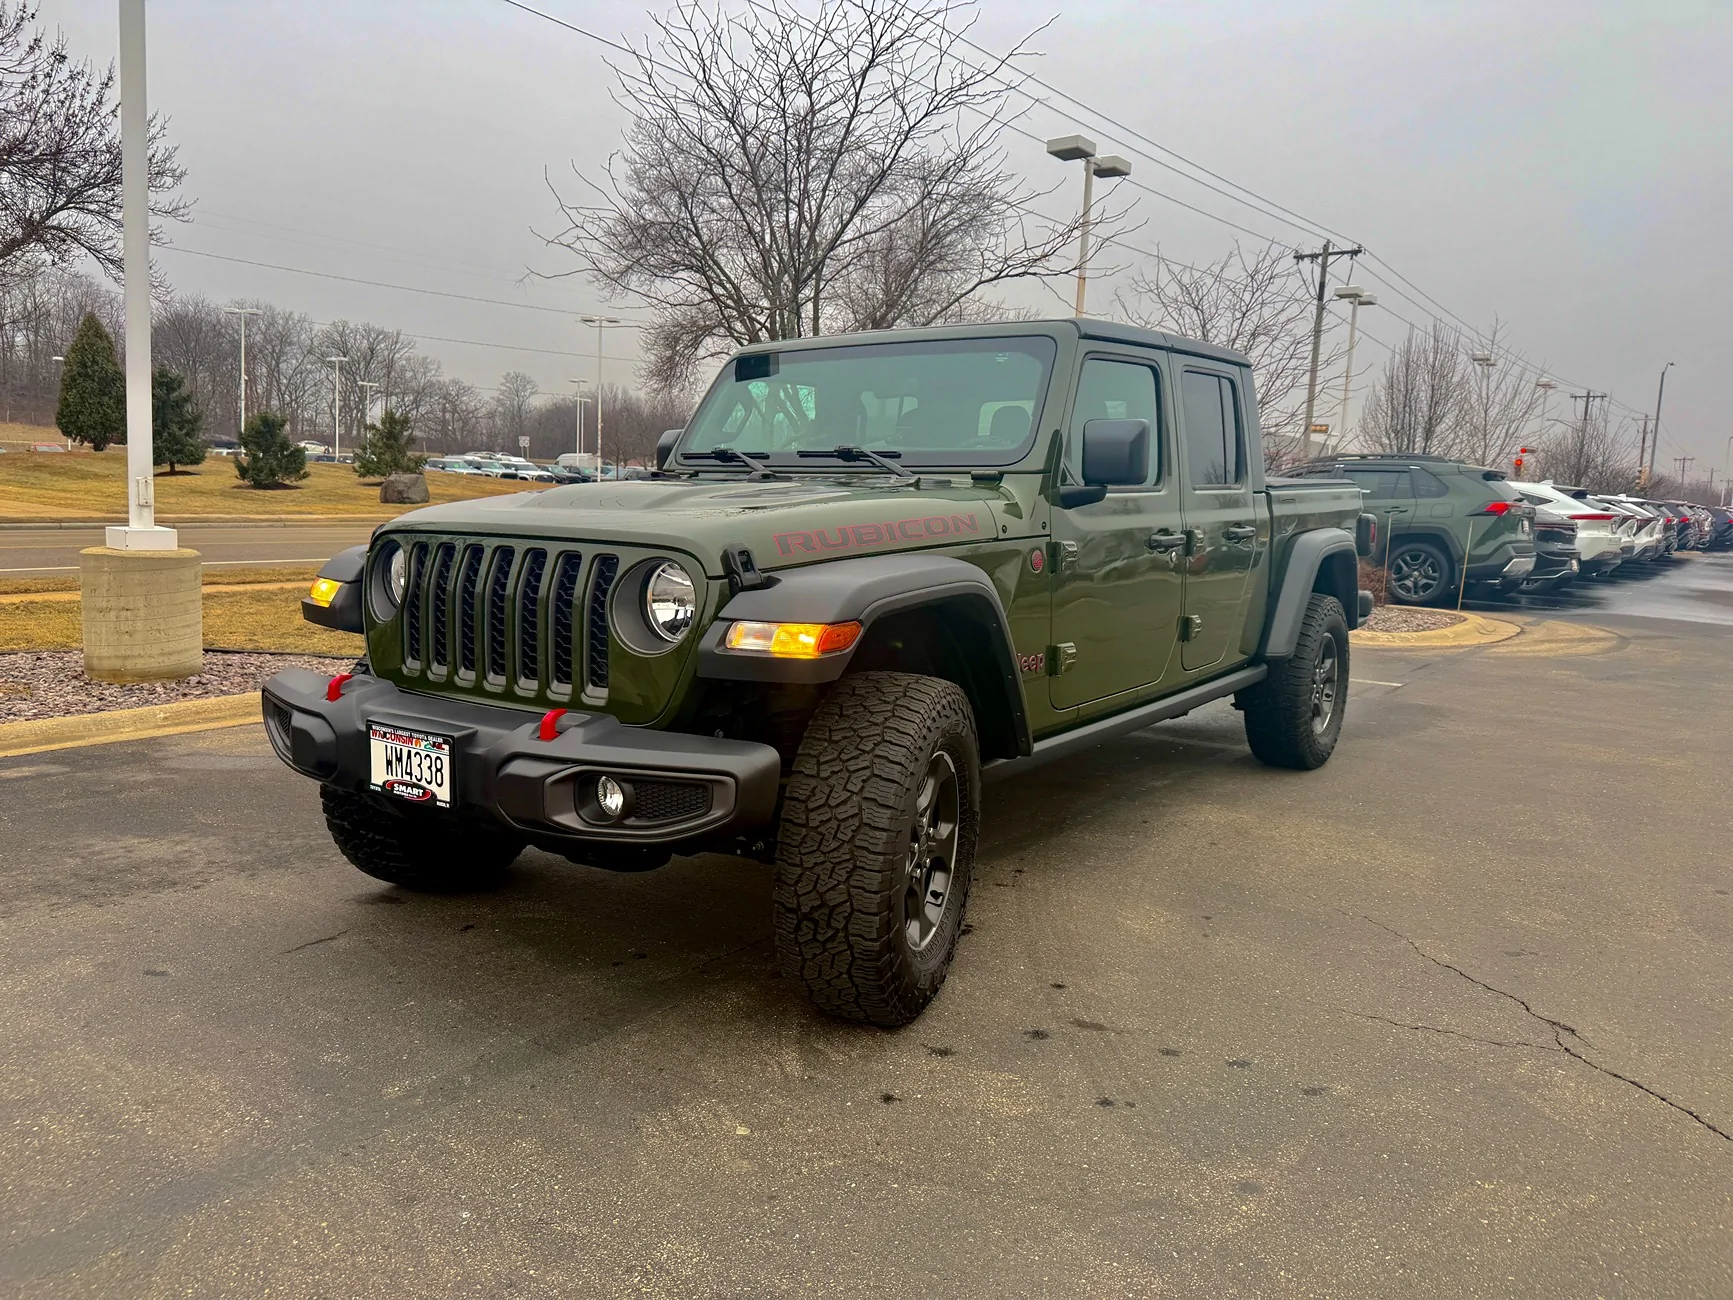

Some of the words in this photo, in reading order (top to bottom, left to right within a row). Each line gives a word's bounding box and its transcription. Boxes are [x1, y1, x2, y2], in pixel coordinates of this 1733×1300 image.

[773, 513, 980, 556] RUBICON
[385, 744, 444, 788] WM4338
[393, 783, 424, 797] SMART
